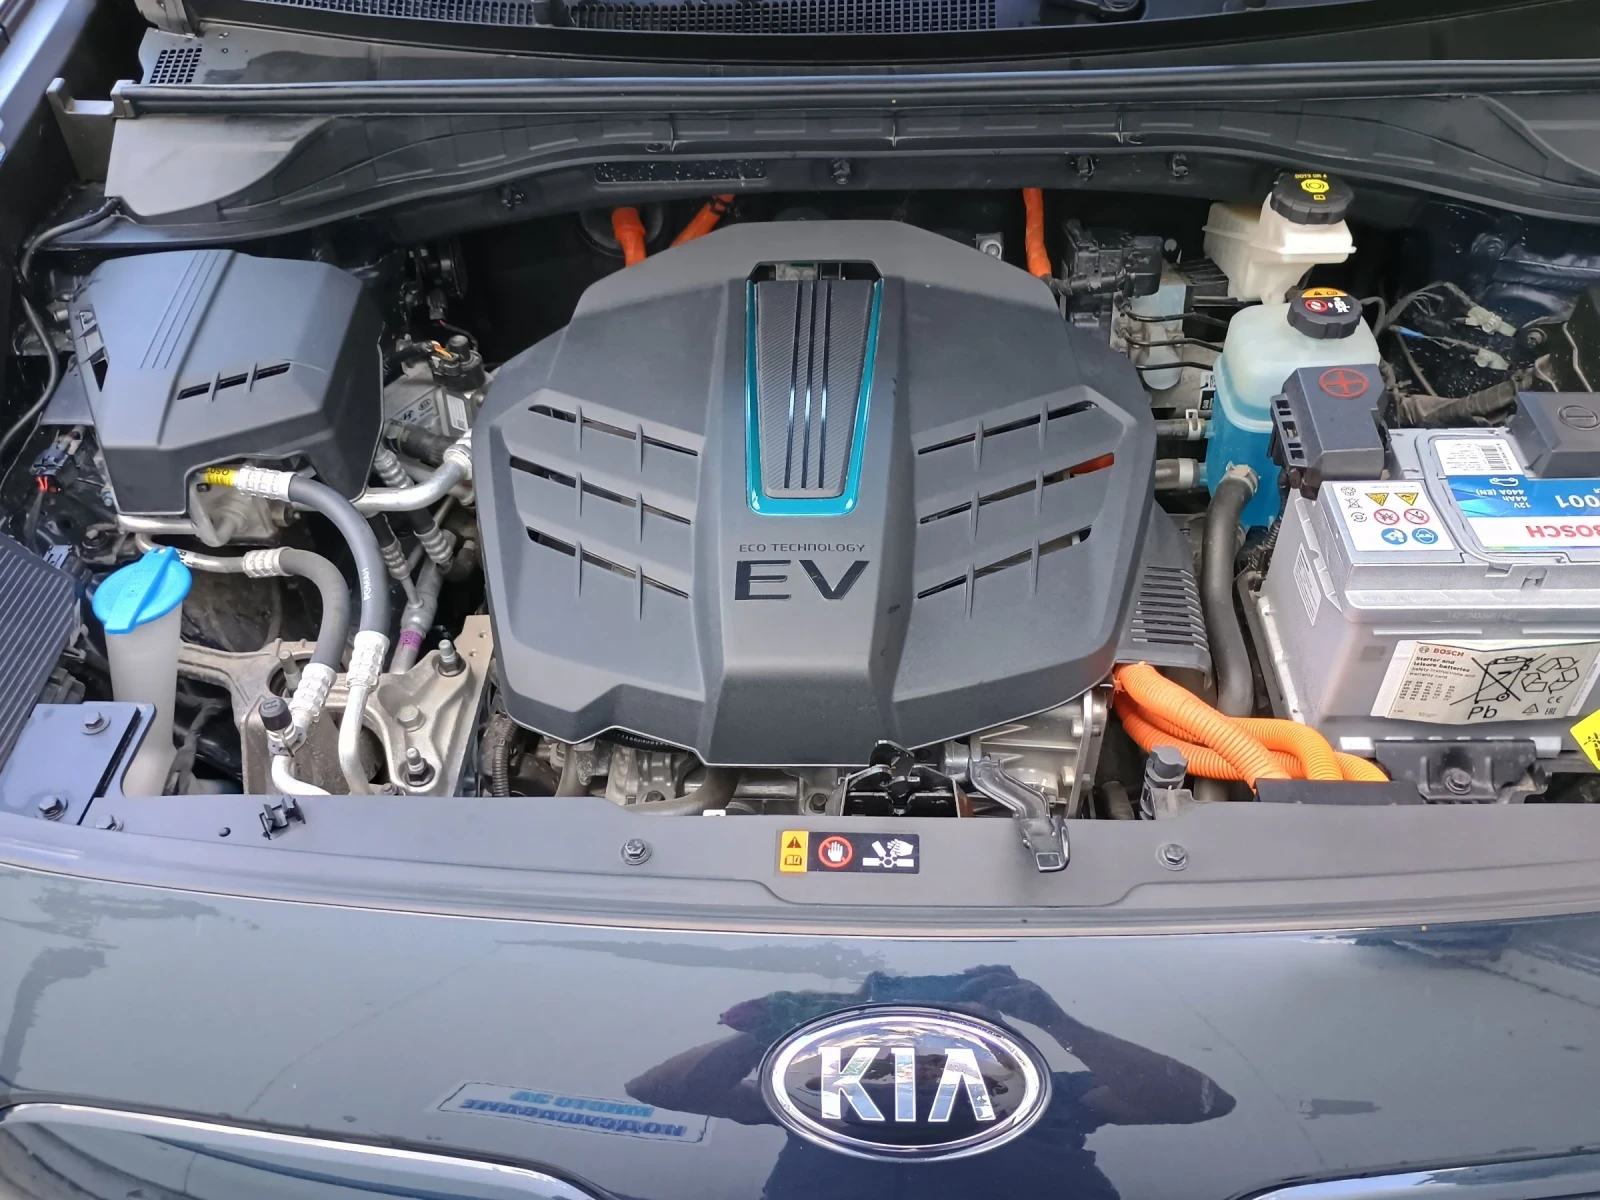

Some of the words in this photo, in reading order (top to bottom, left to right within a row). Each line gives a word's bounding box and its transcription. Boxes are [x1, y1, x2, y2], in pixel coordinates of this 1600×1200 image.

[1476, 488, 1497, 496] (EN)
[739, 543, 766, 553] ECO
[771, 543, 866, 552] TECHNOLOGY
[735, 560, 870, 600] EV
[1433, 648, 1465, 657] BOSCH
[1439, 663, 1470, 673] batteries
[1467, 705, 1498, 720] Pb
[818, 1046, 997, 1122] KIA
